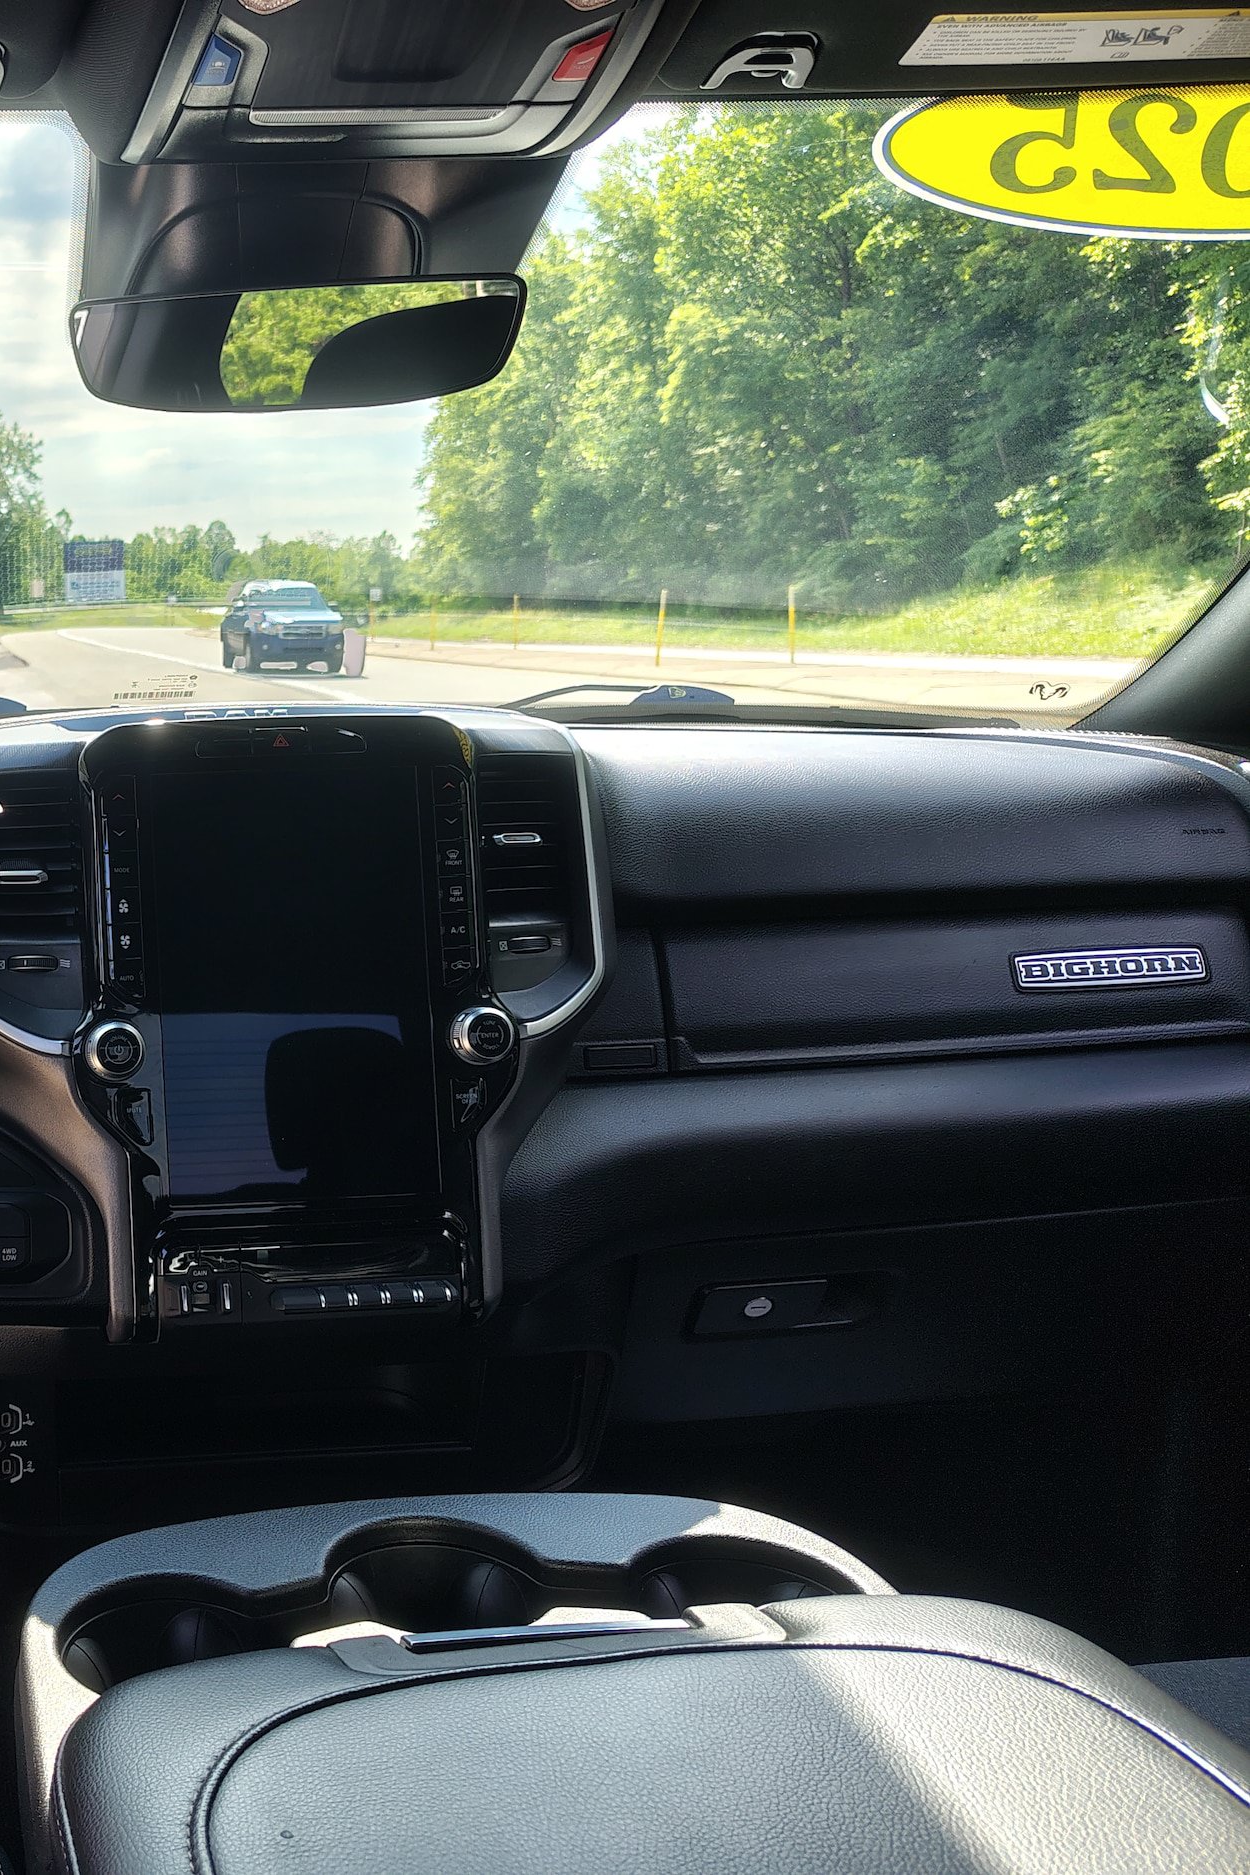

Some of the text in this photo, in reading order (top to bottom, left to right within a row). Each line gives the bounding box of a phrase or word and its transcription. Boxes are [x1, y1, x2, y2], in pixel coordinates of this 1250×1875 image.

[965, 14, 1040, 22] WARNING
[1181, 827, 1226, 835] AIRBAG
[114, 866, 130, 874] MODE
[450, 925, 466, 934] A/C
[1020, 953, 1203, 982] BIGHORN
